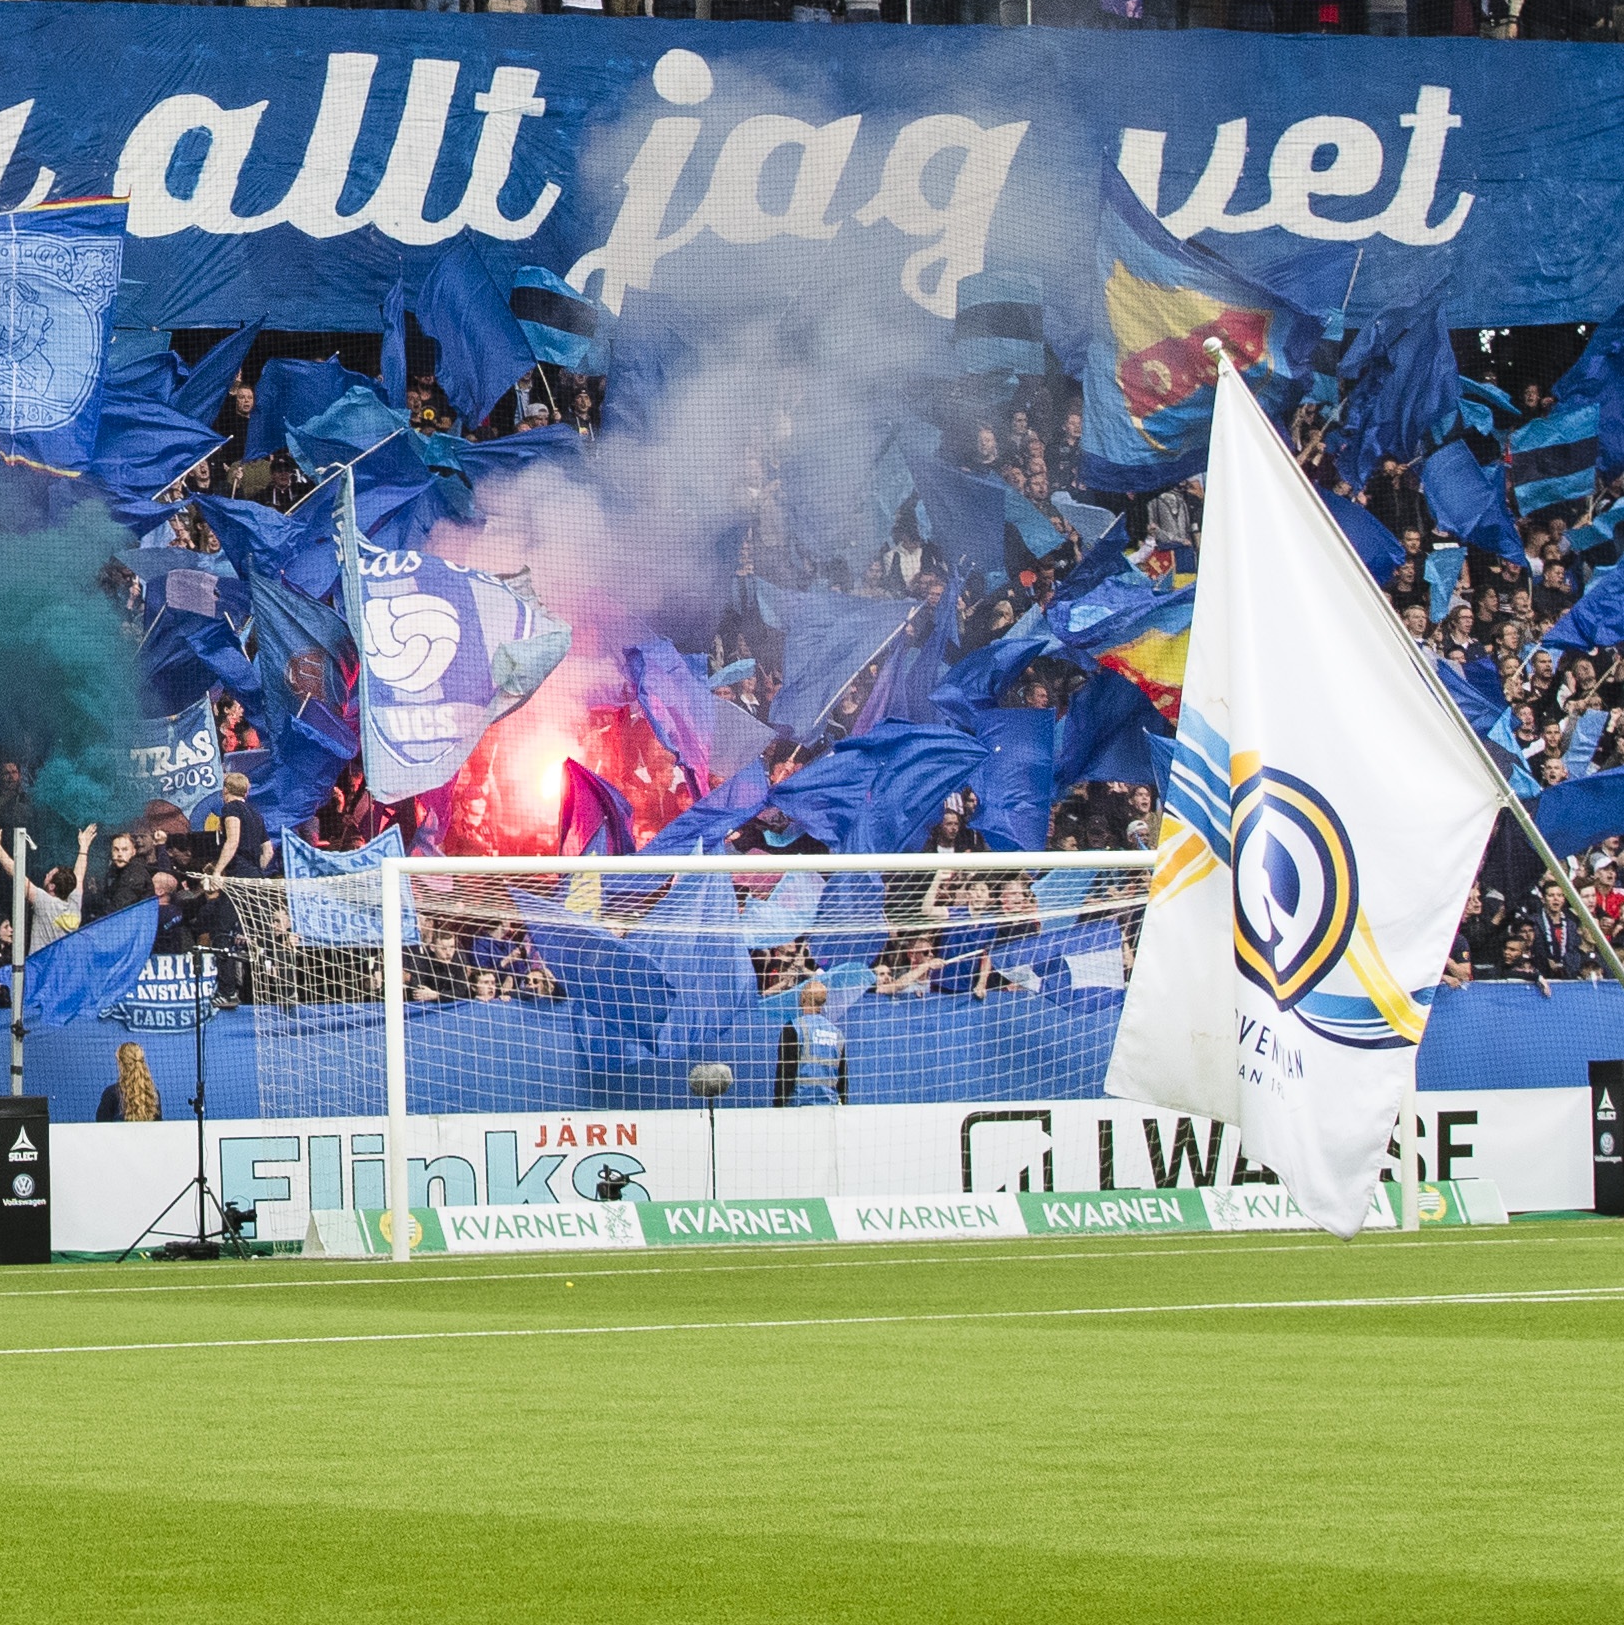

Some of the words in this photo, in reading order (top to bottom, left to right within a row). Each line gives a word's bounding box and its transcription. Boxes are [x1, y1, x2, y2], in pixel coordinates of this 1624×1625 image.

[121, 51, 563, 247] allt
[565, 48, 1030, 317] jag
[1119, 85, 1475, 246] vet
[384, 705, 458, 742] UCS
[160, 765, 216, 792] 2003
[133, 1008, 177, 1027] CAOS
[534, 1117, 638, 1148] JÄRN
[8, 1151, 39, 1162] SELECT
[219, 1130, 651, 1240] Flinks
[2, 1198, 47, 1208] Volkswagen
[1041, 1197, 1184, 1229] KVARNEN
[451, 1212, 600, 1241] KVARNEN
[664, 1206, 814, 1236] KVARNEN
[856, 1204, 1000, 1232] KVARNEN
